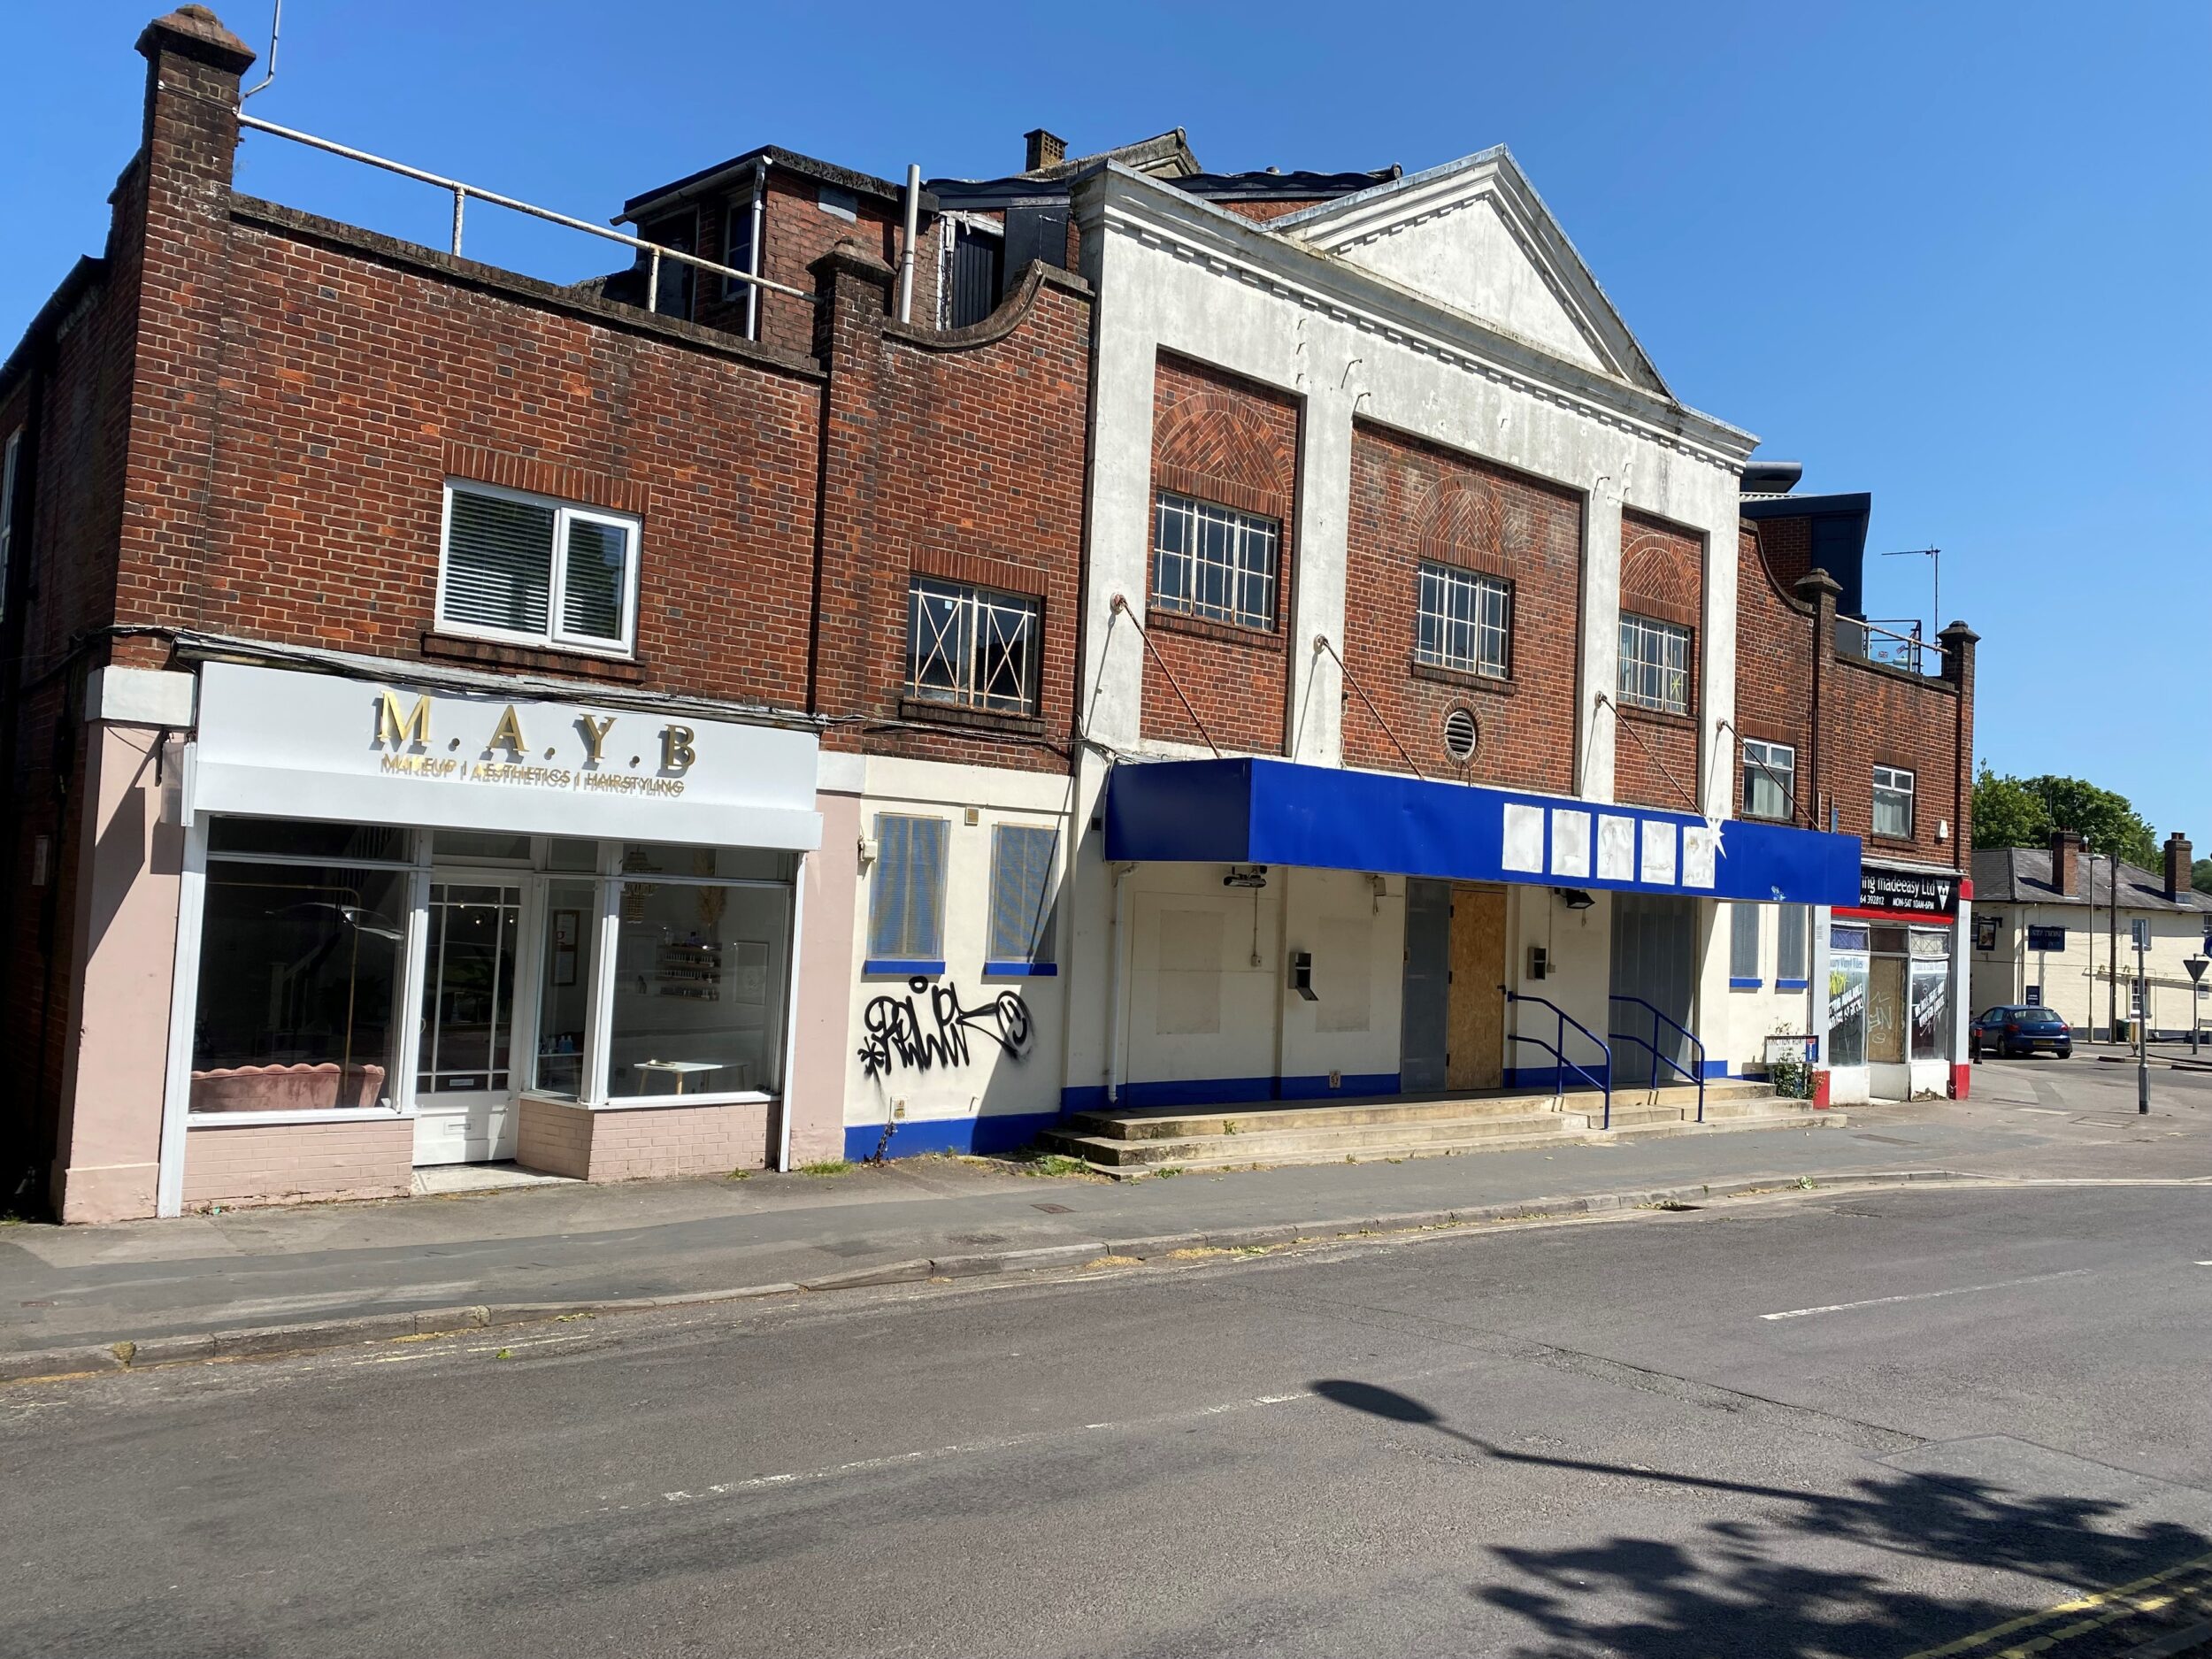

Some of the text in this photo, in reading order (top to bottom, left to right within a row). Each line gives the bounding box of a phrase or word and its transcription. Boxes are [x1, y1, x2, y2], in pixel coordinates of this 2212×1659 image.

[384, 753, 457, 773] MAKEUP
[472, 763, 571, 784] AESTHETICS
[587, 772, 685, 794] HAIRSTYLING
[1878, 874, 1919, 898] madeeasy
[1922, 878, 1935, 896] Ltd
